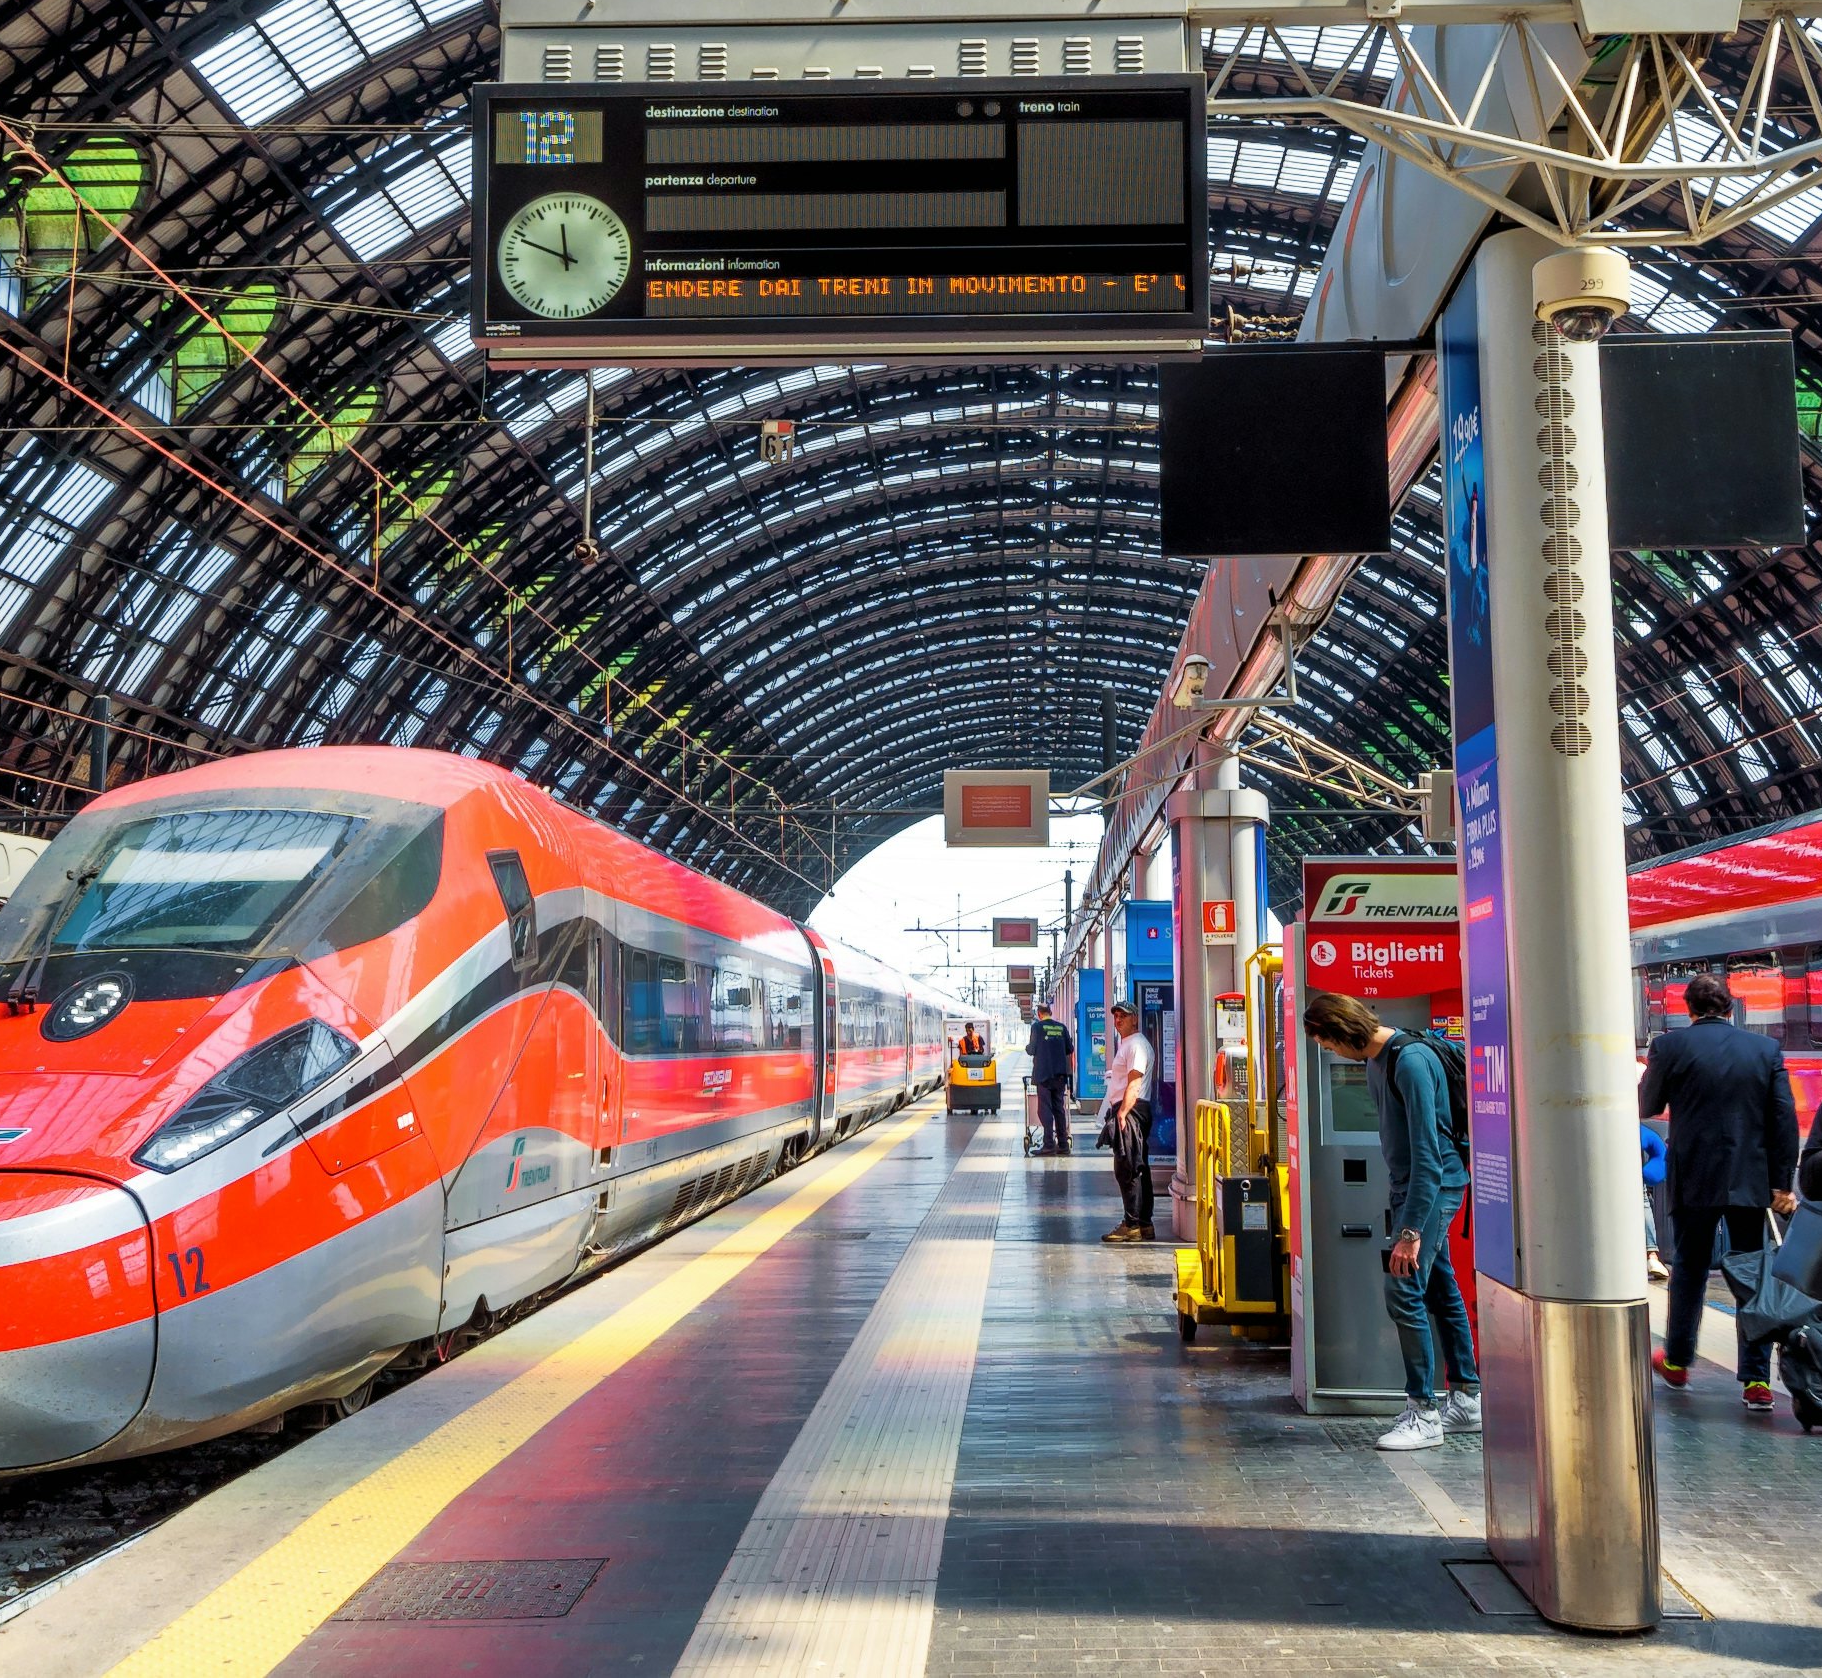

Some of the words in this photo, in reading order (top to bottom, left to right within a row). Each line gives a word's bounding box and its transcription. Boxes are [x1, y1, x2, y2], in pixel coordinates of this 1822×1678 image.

[645, 105, 725, 118] destinazione
[727, 104, 779, 117] destination
[1018, 101, 1055, 113] treno
[1057, 101, 1081, 112] train
[520, 111, 575, 164] 12
[645, 174, 704, 188] partenza
[706, 173, 757, 186] departure
[645, 258, 725, 272] informazioni
[727, 257, 780, 271] information
[759, 278, 801, 297] DAI
[818, 277, 892, 296] TRENI
[907, 277, 934, 295] IN
[950, 275, 1086, 295] MOVIMENTO
[1466, 817, 1482, 846] FIBRA
[1481, 809, 1497, 837] PLUS
[1364, 905, 1459, 917] TRENITALIA
[1351, 942, 1444, 967] Biglietti
[1351, 965, 1394, 979] Tickets
[1363, 986, 1378, 995] 378
[1484, 1044, 1506, 1093] TIM
[167, 1246, 211, 1298] 12
